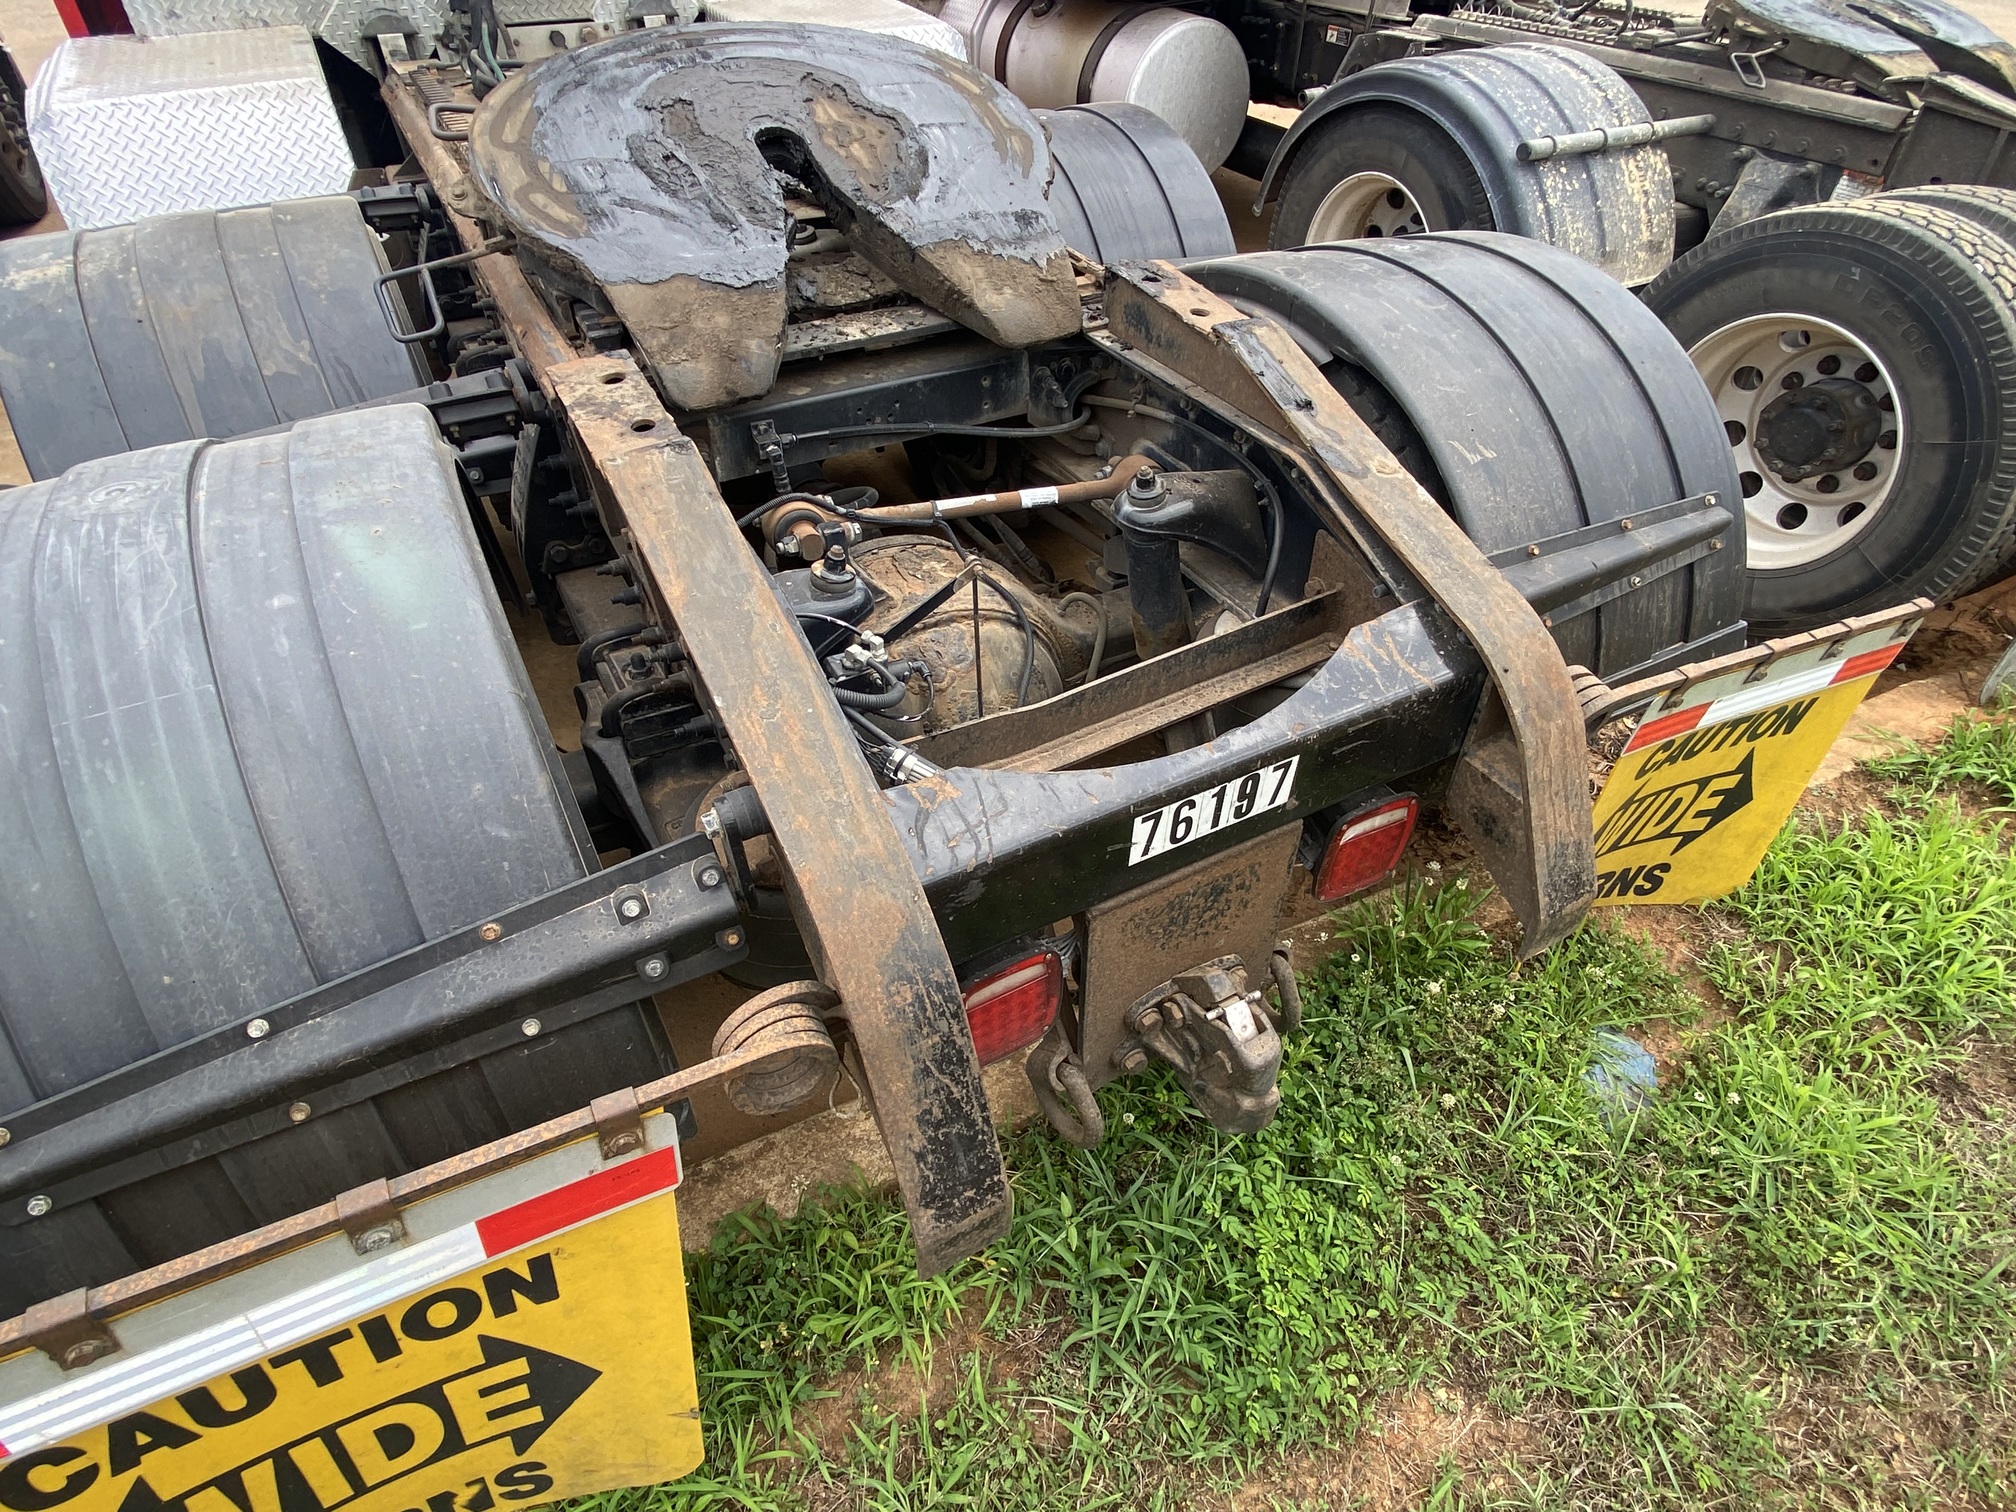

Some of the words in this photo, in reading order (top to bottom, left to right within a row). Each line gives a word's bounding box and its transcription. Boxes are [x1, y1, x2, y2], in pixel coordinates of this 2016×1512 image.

[1635, 697, 1820, 780] CAUTION
[1141, 759, 1293, 858] 76197
[1594, 773, 1745, 857] WIDE
[0, 1253, 561, 1511] CAUTION
